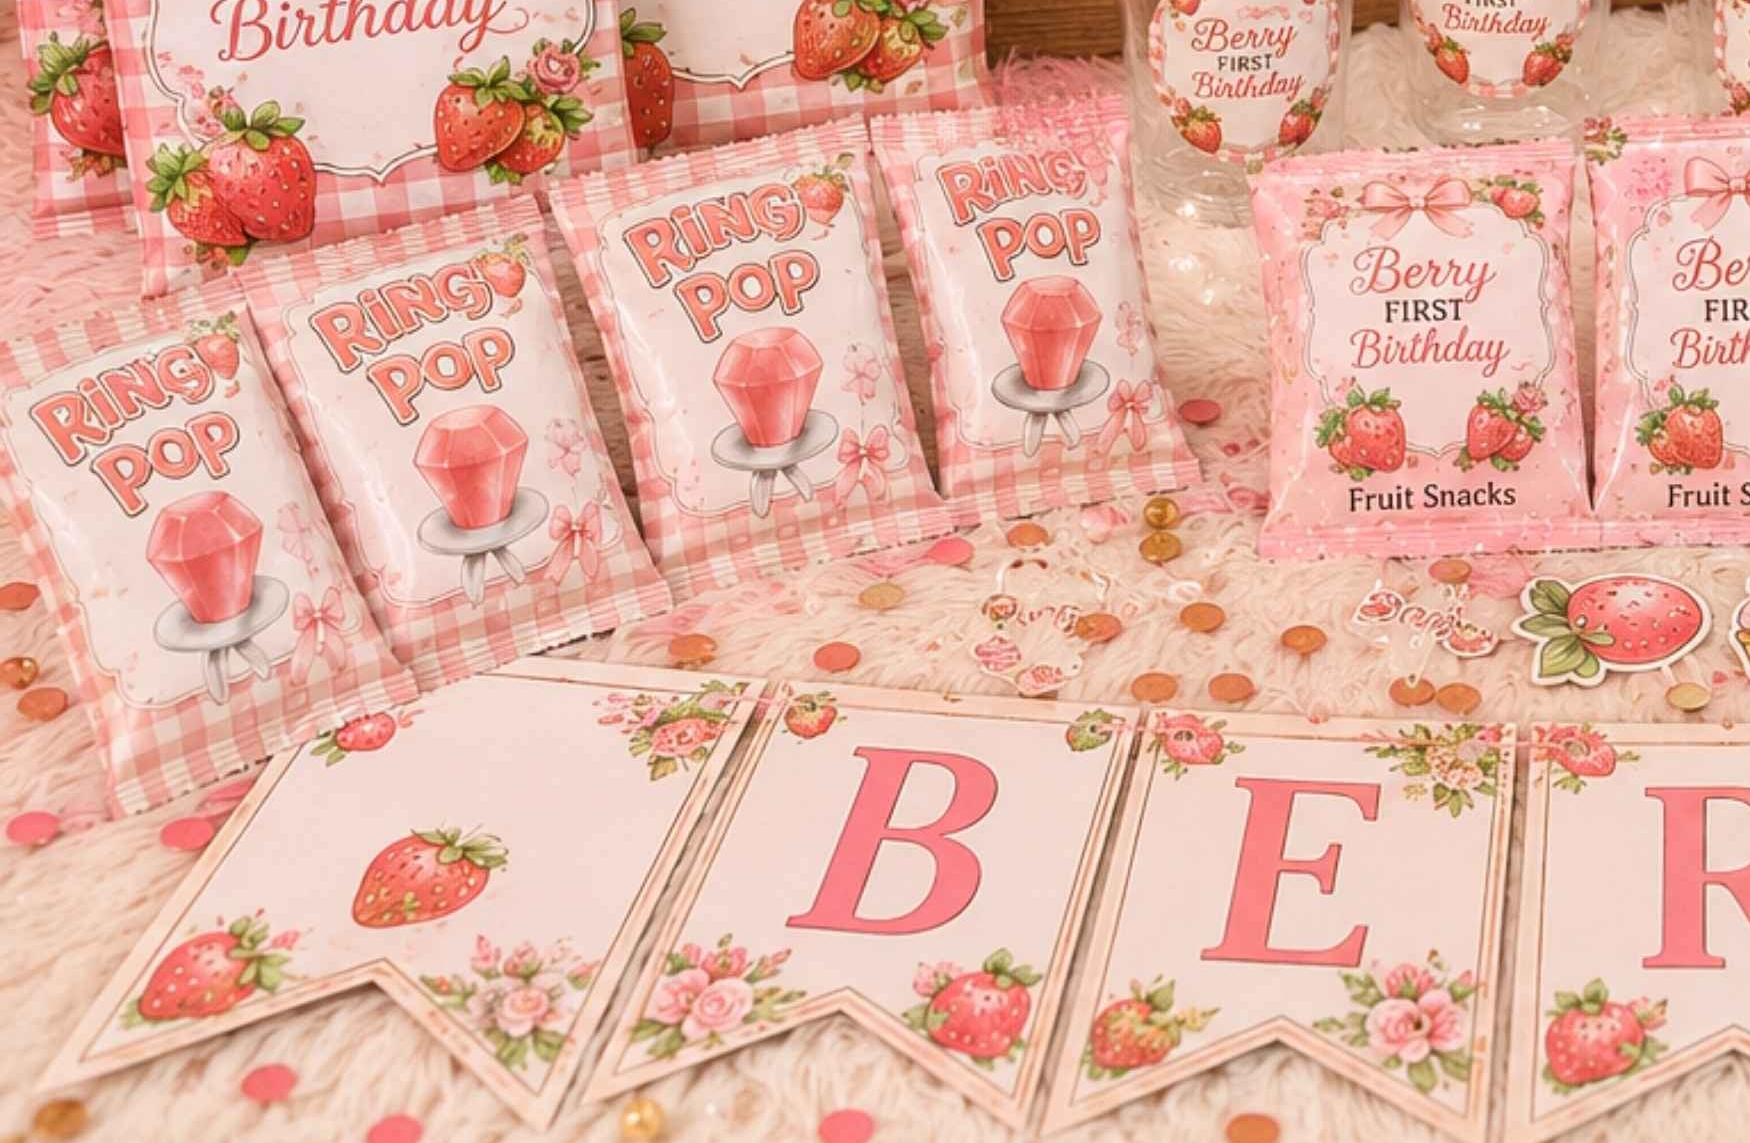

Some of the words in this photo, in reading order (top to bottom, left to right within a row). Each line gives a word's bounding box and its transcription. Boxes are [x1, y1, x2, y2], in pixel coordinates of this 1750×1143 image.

[1191, 17, 1297, 57] Berry
[1442, 3, 1551, 41] Birthday
[1217, 54, 1272, 72] FIRST
[1192, 70, 1304, 101] Birthday
[976, 208, 1100, 282] POP
[1349, 246, 1496, 302] Berry
[674, 249, 820, 342] POP
[1385, 298, 1464, 323] FIRST
[1349, 326, 1510, 377] Birthday
[366, 327, 515, 425] POP
[90, 409, 240, 517] POP
[1349, 485, 1413, 511] Fruit
[1424, 482, 1516, 508] Snacks
[1667, 482, 1732, 507] Fruit
